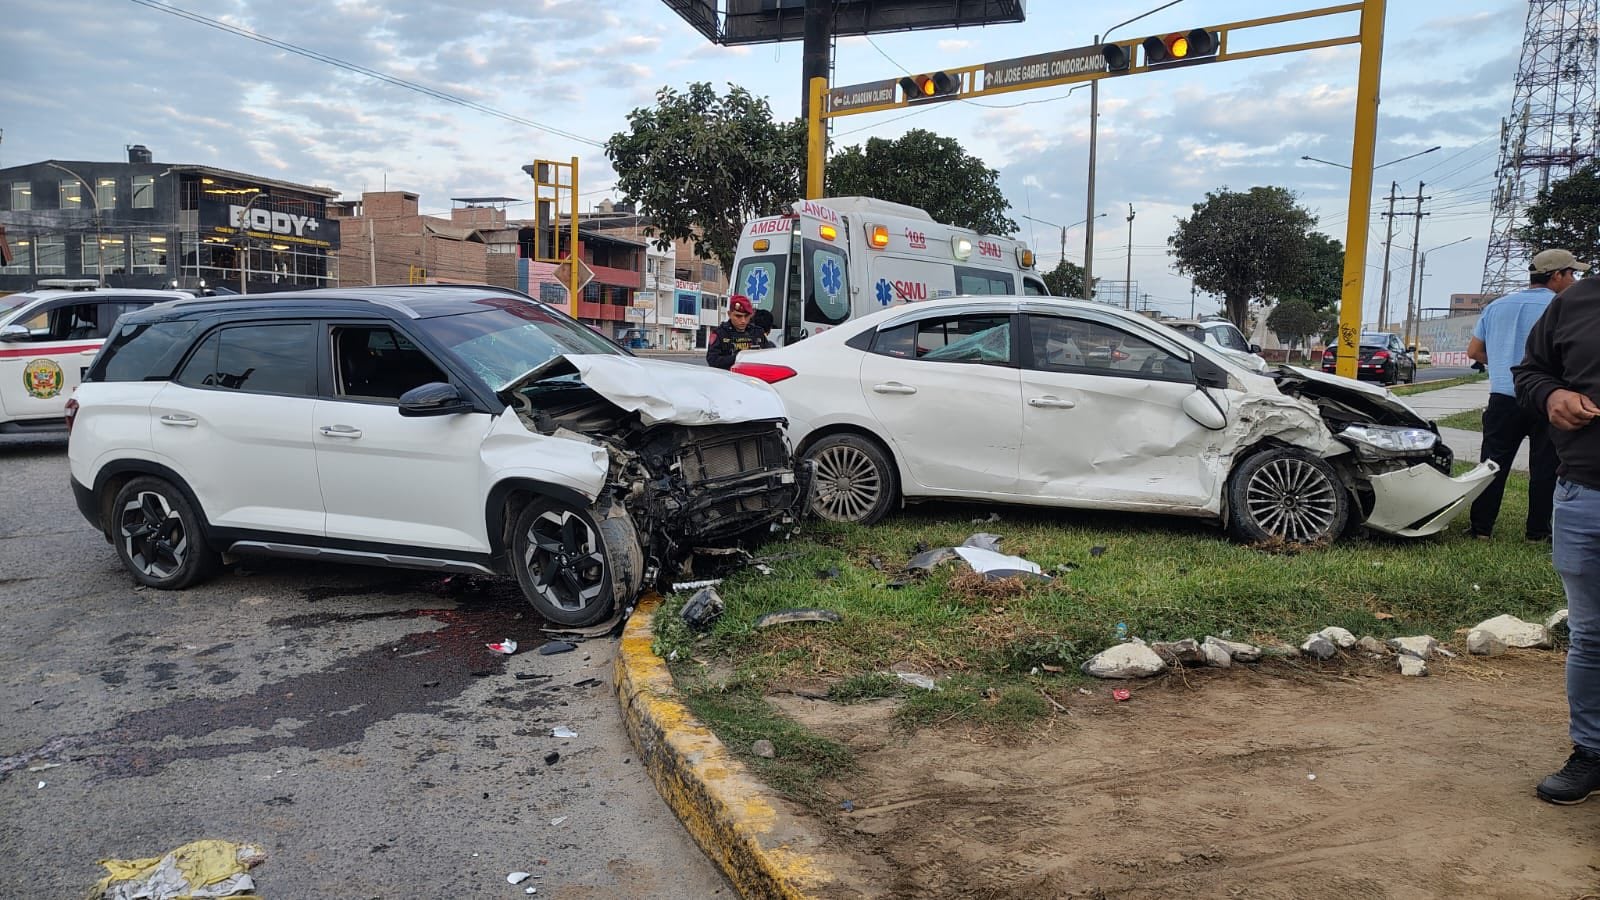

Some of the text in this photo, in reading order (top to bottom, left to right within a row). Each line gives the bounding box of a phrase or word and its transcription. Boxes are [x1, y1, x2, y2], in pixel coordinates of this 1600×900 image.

[993, 69, 1004, 85] AV.
[1004, 66, 1021, 83] JOSE
[1021, 61, 1050, 80] GABRIEL
[908, 230, 926, 244] 106
[978, 240, 1002, 258] SAMU
[895, 280, 927, 300] SAMU
